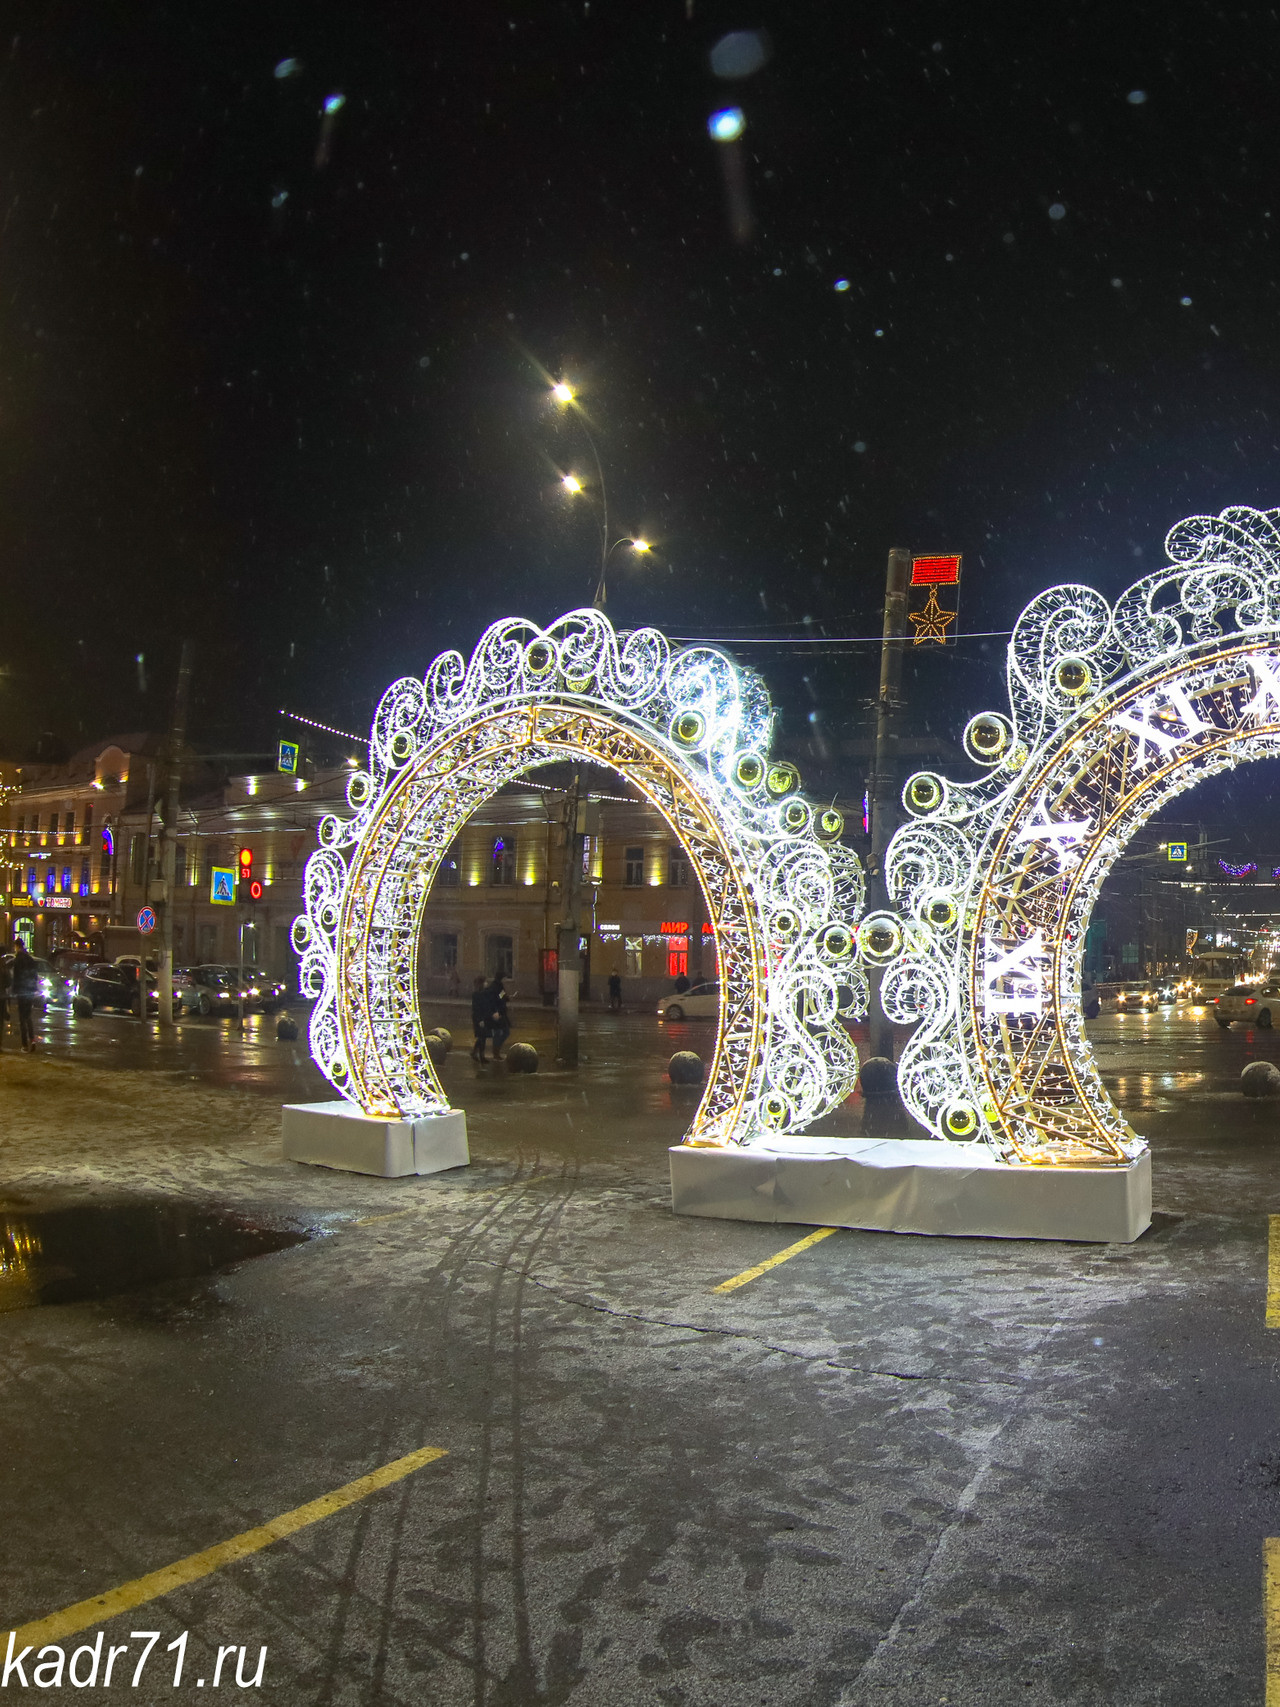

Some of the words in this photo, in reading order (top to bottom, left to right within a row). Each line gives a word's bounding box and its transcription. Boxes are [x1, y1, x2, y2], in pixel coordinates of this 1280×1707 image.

[1013, 786, 1093, 874] X
[1106, 681, 1212, 772] XI
[660, 922, 689, 934] МИР
